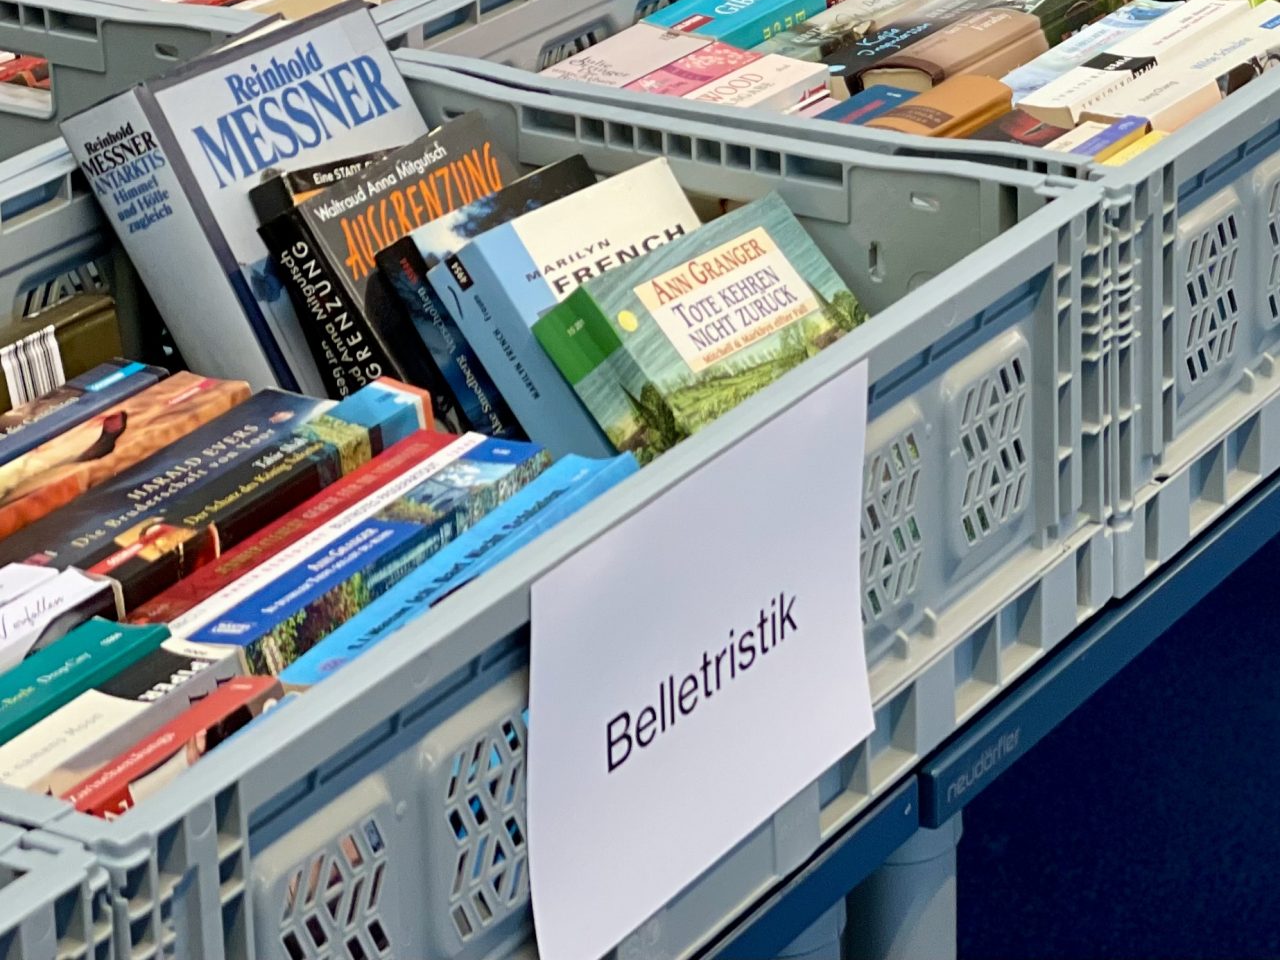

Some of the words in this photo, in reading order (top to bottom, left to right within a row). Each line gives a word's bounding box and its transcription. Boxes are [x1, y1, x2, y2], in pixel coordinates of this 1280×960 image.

[225, 41, 324, 106] Reinhold
[84, 122, 134, 156] Reinhold
[191, 55, 402, 189] MESSNER
[82, 130, 158, 178] MESSNER
[94, 150, 166, 195] ANTARKTIS
[312, 168, 334, 186] Eine
[113, 175, 159, 207] Himmel
[117, 203, 138, 222] und
[137, 190, 170, 214] Hölle
[314, 189, 368, 224] Waltraud
[367, 173, 398, 200] Anna
[396, 140, 448, 181] Mitgutsch
[129, 203, 174, 234] zugleich
[340, 141, 504, 282] AUSGRENZUNG
[525, 237, 612, 283] MARILYN
[552, 223, 686, 294] FRENCH
[689, 236, 768, 286] GRANGER
[280, 250, 328, 322] Mitgutsch
[291, 240, 383, 380] GRENZUNG
[671, 294, 723, 331] TOTE
[720, 264, 782, 307] KEHREN
[324, 322, 353, 364] Anna
[416, 286, 457, 355] Verschollen
[492, 327, 518, 363] FRENCH
[687, 314, 742, 354] NICHT
[455, 353, 494, 415] Smedberg
[514, 360, 541, 400] MARILYN
[127, 455, 203, 502] HARALD
[201, 423, 259, 459] EVERS
[605, 591, 799, 774] Belletristik
